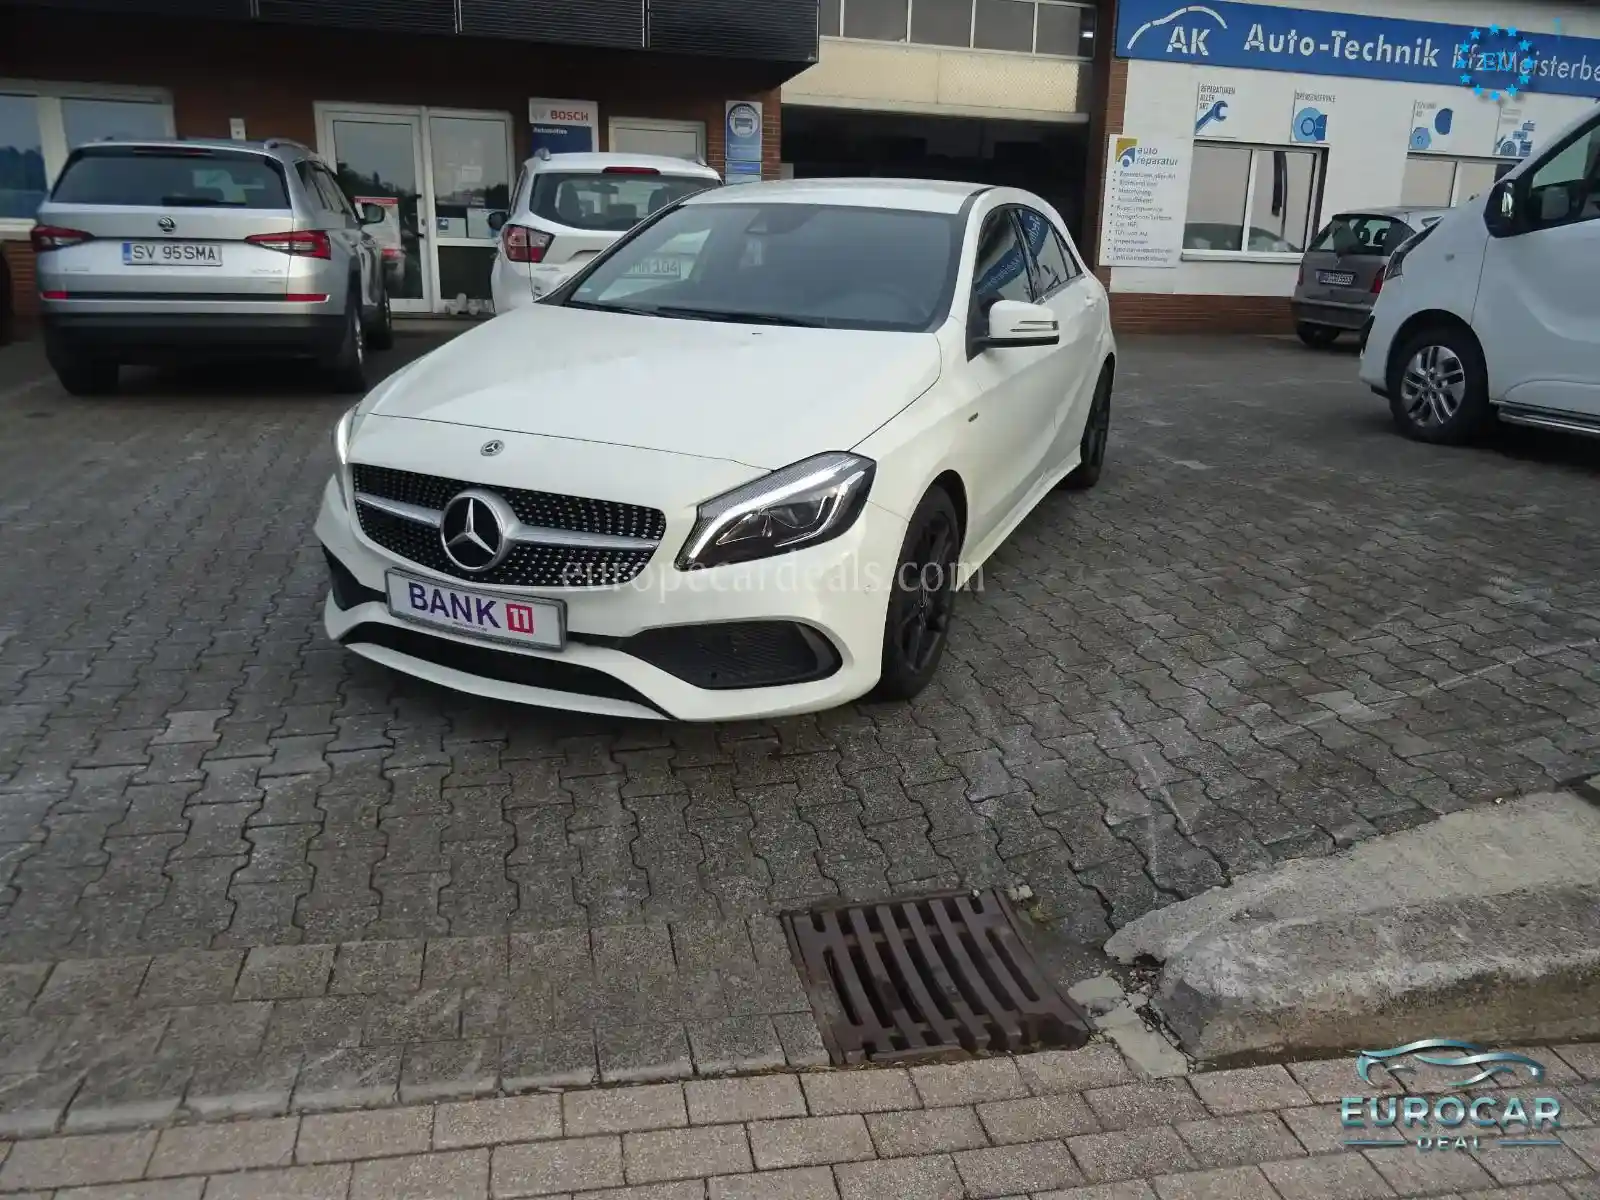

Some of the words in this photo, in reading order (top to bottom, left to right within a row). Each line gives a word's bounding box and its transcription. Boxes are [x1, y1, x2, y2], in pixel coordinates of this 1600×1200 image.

[1166, 26, 1211, 56] AK
[1244, 23, 1440, 68] Auto-Technik
[550, 110, 589, 121] BOSCH
[533, 127, 568, 135] Automotive
[1137, 147, 1158, 155] auto
[1135, 157, 1178, 166] reparatur
[132, 245, 156, 260] SV
[408, 582, 502, 628] BANK
